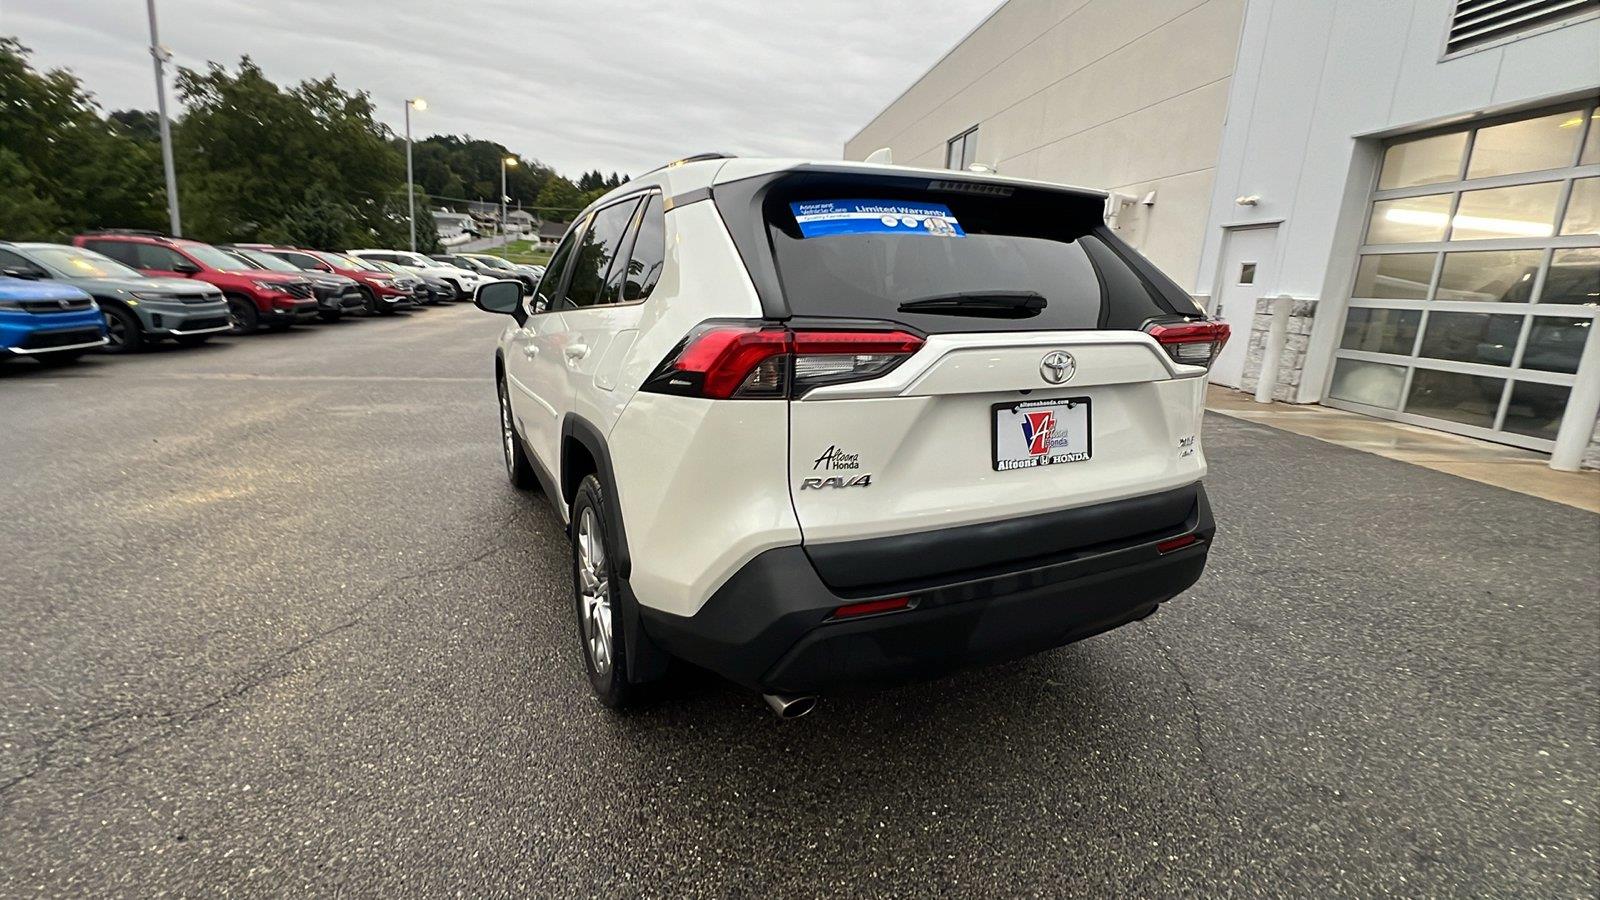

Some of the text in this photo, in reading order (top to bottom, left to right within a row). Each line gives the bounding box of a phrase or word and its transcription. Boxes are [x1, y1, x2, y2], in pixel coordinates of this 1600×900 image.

[800, 203, 833, 211] Assurant
[855, 205, 946, 218] Limited Warranty
[1020, 399, 1069, 408] altoonahonda.com
[1045, 438, 1069, 448] Honda
[813, 445, 859, 470] Altoona
[998, 458, 1038, 471] Altoona
[1053, 452, 1090, 464] HONDA
[833, 461, 859, 470] Honda
[801, 473, 872, 490] RAV4
